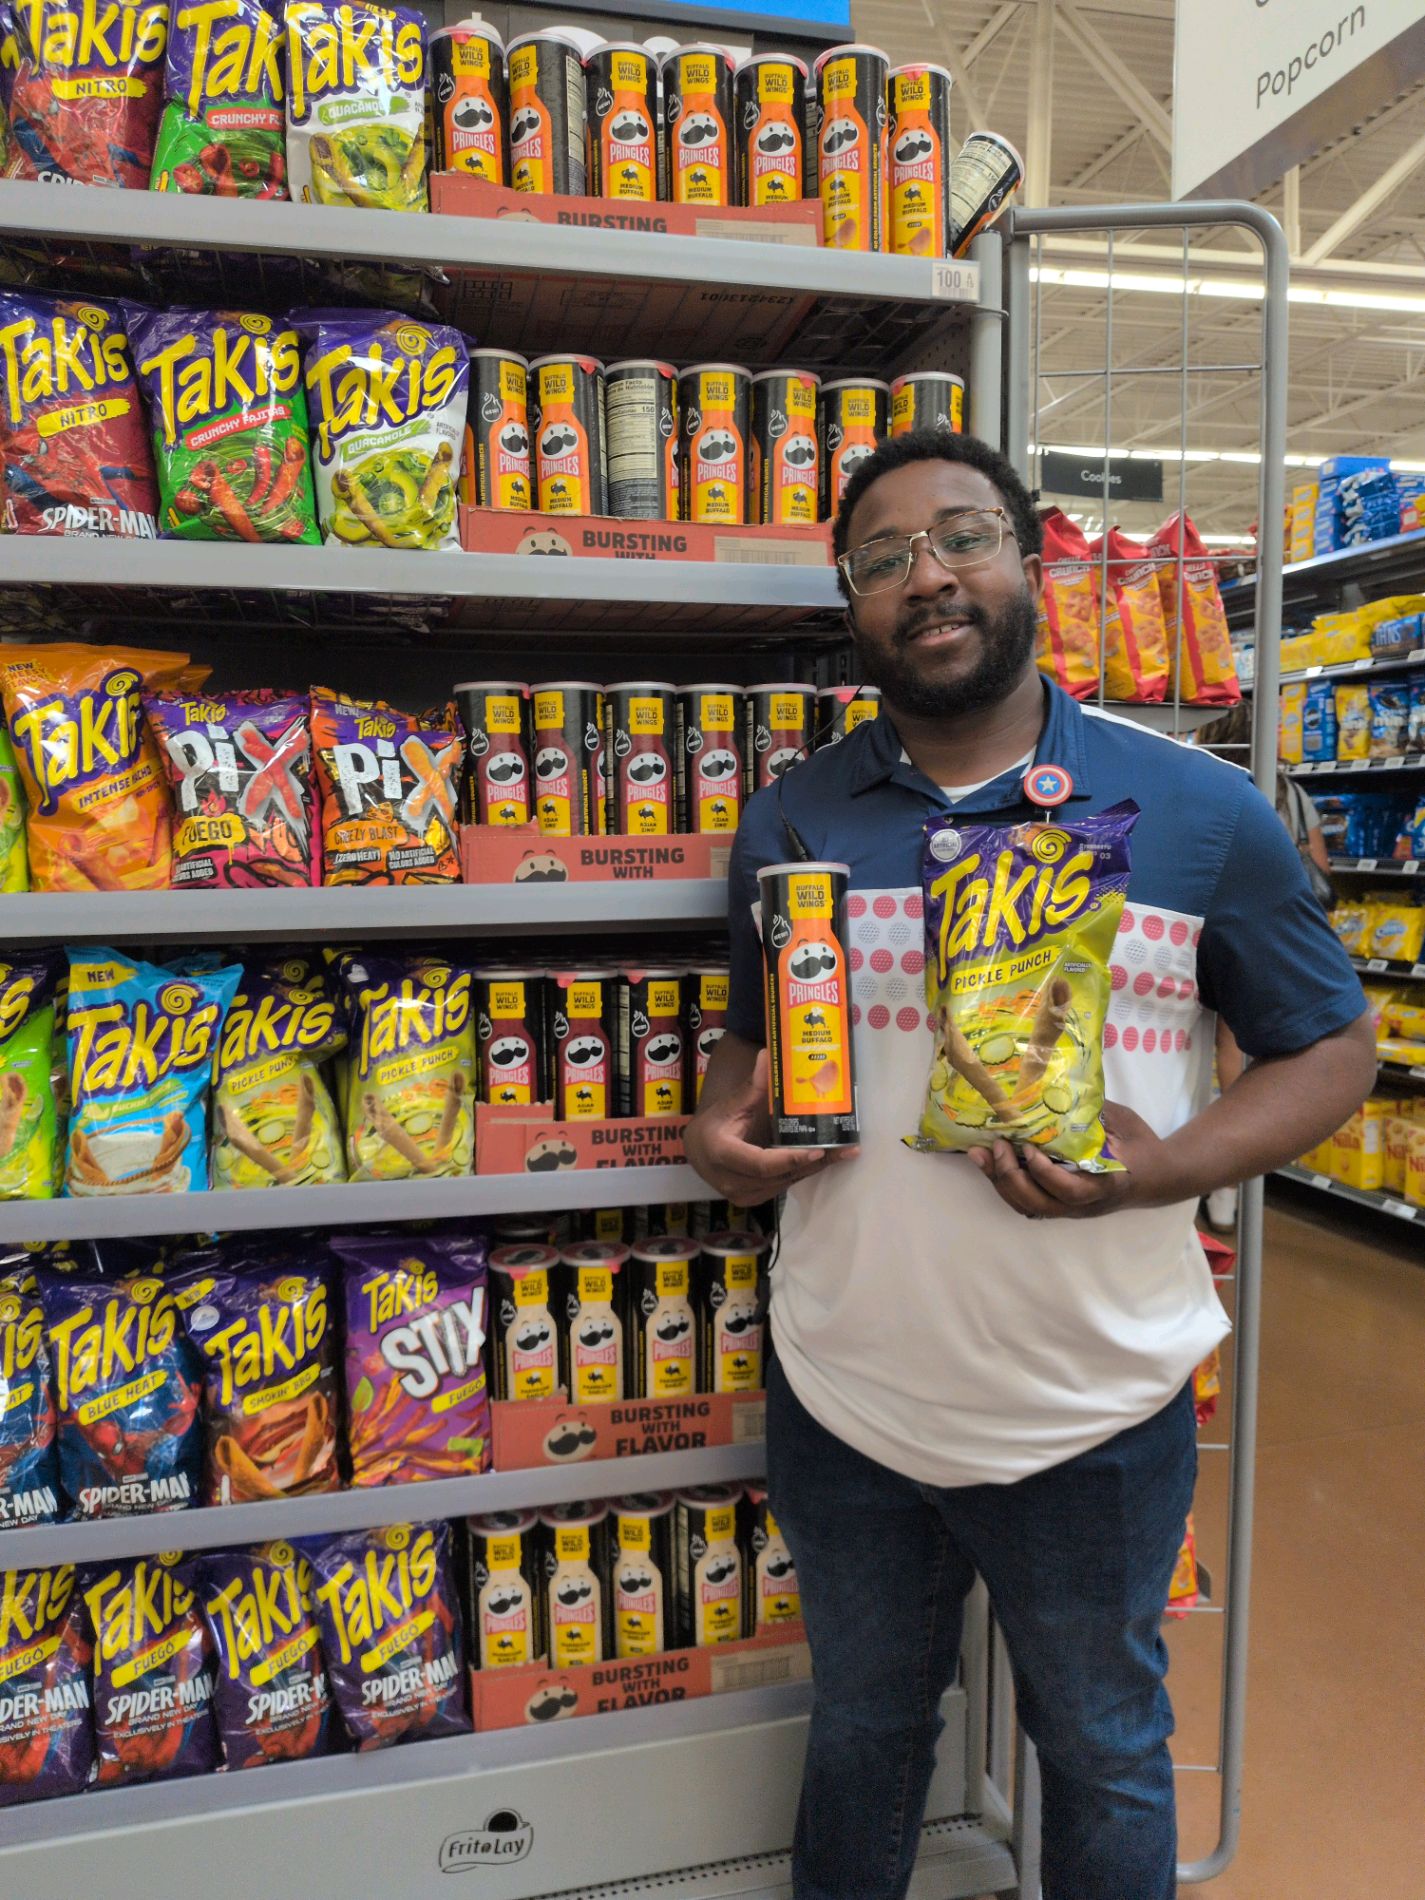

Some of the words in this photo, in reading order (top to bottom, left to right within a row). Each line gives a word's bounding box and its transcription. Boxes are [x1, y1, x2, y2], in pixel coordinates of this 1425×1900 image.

[16, 0, 168, 75] Takis
[176, 1, 287, 119] Tak
[286, 3, 424, 119] Takis
[1257, 5, 1365, 109] Popcorn
[618, 67, 641, 77] WILD
[619, 75, 641, 83] WINGS
[687, 68, 709, 77] WILD
[687, 76, 709, 84] WINGS
[75, 79, 128, 96] NITRO
[765, 78, 788, 88] WILD
[765, 86, 788, 94] WINGS
[901, 86, 924, 96] WILD
[902, 94, 924, 103] WINGS
[211, 112, 266, 127] CRUNCHY
[453, 131, 494, 154] PRINGLES
[610, 144, 649, 166] PRINGLES
[680, 147, 719, 168] PRINGLES
[822, 152, 859, 177] PRINGLES
[755, 156, 796, 178] PRINGLES
[894, 163, 934, 186] PRINGLES
[557, 211, 667, 233] BURSTING
[937, 270, 961, 288] 100
[0, 317, 129, 423] Takis
[142, 327, 299, 446] Takis
[544, 379, 566, 389] WILD
[545, 387, 567, 395] WINGS
[706, 387, 729, 395] WILD
[306, 343, 457, 459] Takis
[848, 403, 870, 411] WILD
[61, 405, 107, 427] NITRO
[191, 418, 240, 447] CRUNCHY
[243, 406, 286, 432] FAJITAS
[348, 425, 412, 454] GUACAMOLE
[542, 455, 579, 477] PRINGLES
[697, 464, 736, 483] PRINGLES
[782, 466, 816, 488] PRINGLES
[1081, 470, 1121, 484] Cooes
[583, 531, 687, 552] BURSTING
[8, 662, 33, 673] NEW
[180, 702, 227, 726] Takis
[493, 710, 514, 718] WILD
[493, 717, 516, 725] WINGS
[538, 706, 557, 715] WILD
[636, 711, 658, 719] WILD
[707, 708, 728, 716] WILD
[776, 707, 798, 715] WILD
[354, 716, 397, 739] Takis
[79, 777, 131, 808] INTENSE
[487, 783, 525, 802] PRINGLES
[536, 780, 568, 802] PRINGLES
[627, 783, 666, 802] PRINGLES
[700, 780, 737, 797] PRINGLES
[183, 820, 233, 843] FUEGO
[369, 826, 398, 841] BLAST
[389, 859, 414, 870] COLORS
[413, 856, 435, 866] ADDED
[390, 850, 400, 861] NO
[400, 848, 434, 859] ARTIFICIAL
[581, 848, 685, 865] BURSTING
[613, 866, 653, 879] WITH
[797, 890, 825, 900] WILD
[797, 900, 825, 908] WINGS
[930, 850, 1093, 982] Takis
[87, 968, 115, 983] NEW
[955, 968, 1004, 991] PICKLE
[1009, 950, 1051, 978] PUNCH
[495, 996, 518, 1004] WILD
[573, 996, 596, 1004] WILD
[654, 994, 675, 1002] WILD
[706, 988, 727, 996] WILD
[789, 981, 839, 1005] PRINGLES
[360, 974, 471, 1076] Takis
[770, 1005, 778, 1040] ARTIFICIAL
[67, 1003, 218, 1108] Takis
[380, 1061, 417, 1082] PICKLE
[422, 1049, 456, 1068] PUNCH
[231, 1069, 266, 1092] PICKLE
[489, 1067, 529, 1085] PRINGLES
[565, 1066, 604, 1084] PRINGLES
[645, 1063, 681, 1081] PRINGLES
[622, 1144, 662, 1155] WITH
[183, 1291, 202, 1305] NEW
[362, 1270, 438, 1333] Takis
[50, 1294, 175, 1412] Takis
[204, 1285, 327, 1405] Takis
[380, 1286, 486, 1399] STIX
[293, 1374, 312, 1392] BBQ
[448, 1379, 483, 1405] FUEGO
[87, 1393, 119, 1419] BLUE
[126, 1376, 158, 1397] HEAT
[611, 1402, 710, 1424] BURSTING
[642, 1421, 681, 1435] WITH
[616, 1431, 707, 1456] FLAVOR
[21, 1514, 39, 1524] DAY
[0, 1562, 76, 1648] kis
[316, 1530, 436, 1664] Takis
[84, 1561, 195, 1677] Takis
[378, 1623, 419, 1662] FUEGO
[134, 1642, 175, 1675] FUEGO
[268, 1638, 308, 1674] FUEGO
[361, 1651, 458, 1705] SPIDER-MAN
[592, 1656, 690, 1686] BURSTING
[622, 1677, 661, 1694] WITH
[0, 1681, 90, 1722] DER-MAN
[105, 1673, 214, 1726] SPIDER-MAN
[597, 1686, 687, 1713] FLAVOR
[26, 1714, 48, 1726] NEW
[128, 1713, 160, 1726] BRAND
[162, 1710, 182, 1720] NEW
[183, 1703, 199, 1712] DAY
[256, 1715, 304, 1735] EXCLUSIVELY
[114, 1724, 166, 1739] EXCLUSIVELY
[167, 1720, 176, 1729] IN
